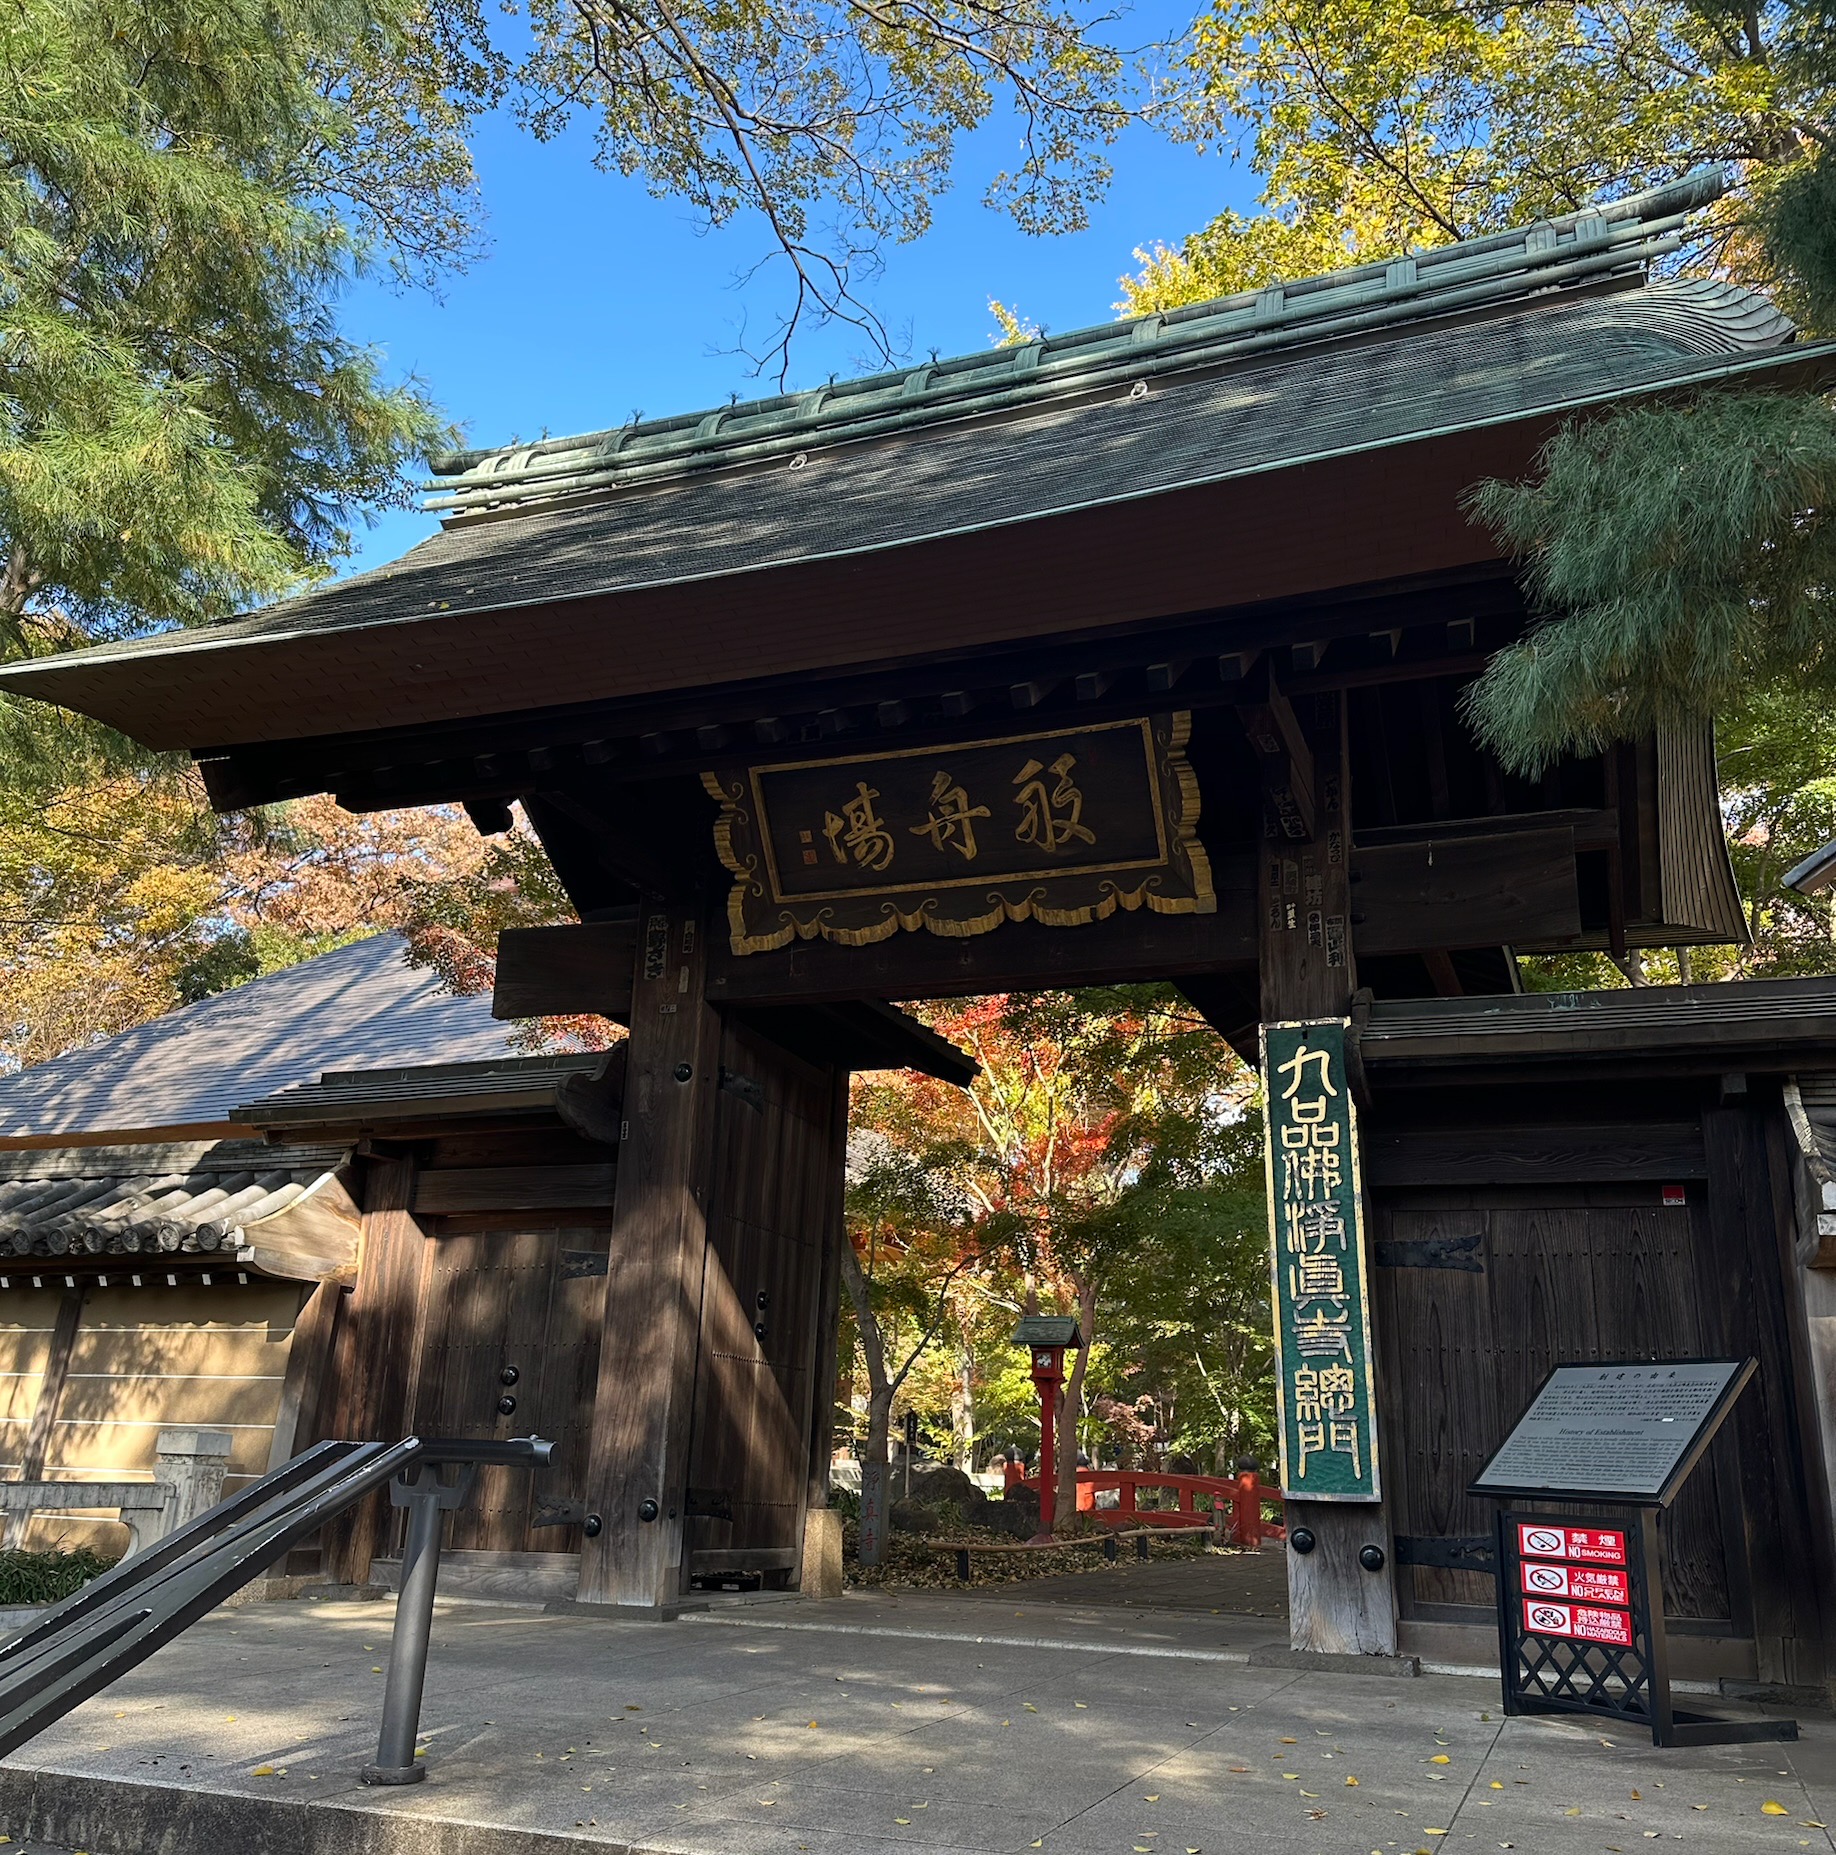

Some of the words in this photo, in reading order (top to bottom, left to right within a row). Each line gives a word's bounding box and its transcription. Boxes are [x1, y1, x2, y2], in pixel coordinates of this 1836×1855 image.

[1559, 1428, 1584, 1438] History
[1595, 1428, 1645, 1436] Establishment
[1568, 1546, 1580, 1558] NO
[1581, 1549, 1621, 1560] SMOKING
[1574, 1572, 1619, 1586] 火気厳禁
[1571, 1585, 1584, 1597] NO
[1584, 1587, 1624, 1597] OPEN
[1584, 1593, 1624, 1602] FLAME
[1574, 1624, 1586, 1636] NO
[1587, 1627, 1627, 1637] HAZARDOUS
[1587, 1631, 1628, 1642] MATERIALS
